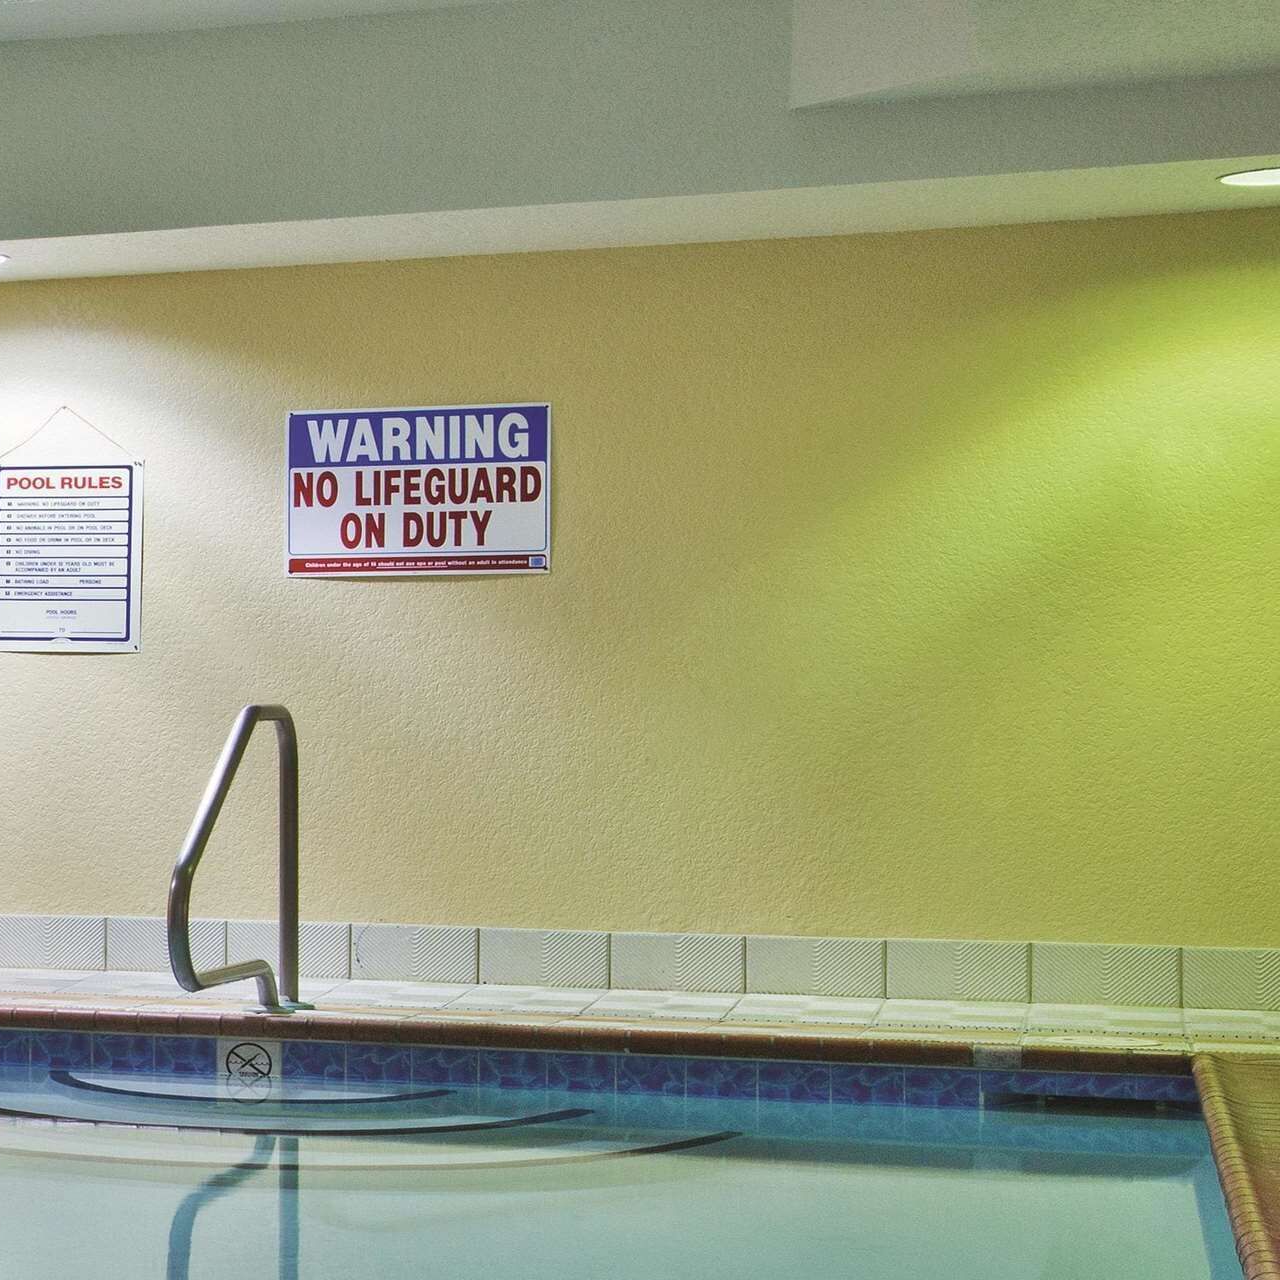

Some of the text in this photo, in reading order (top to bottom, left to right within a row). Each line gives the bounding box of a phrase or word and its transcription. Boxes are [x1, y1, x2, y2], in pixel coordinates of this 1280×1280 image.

[306, 412, 529, 463] WARNING
[6, 476, 123, 490] POOL RULES
[293, 465, 542, 508] NO LIFEGUARD
[340, 510, 492, 549] ON DUTY
